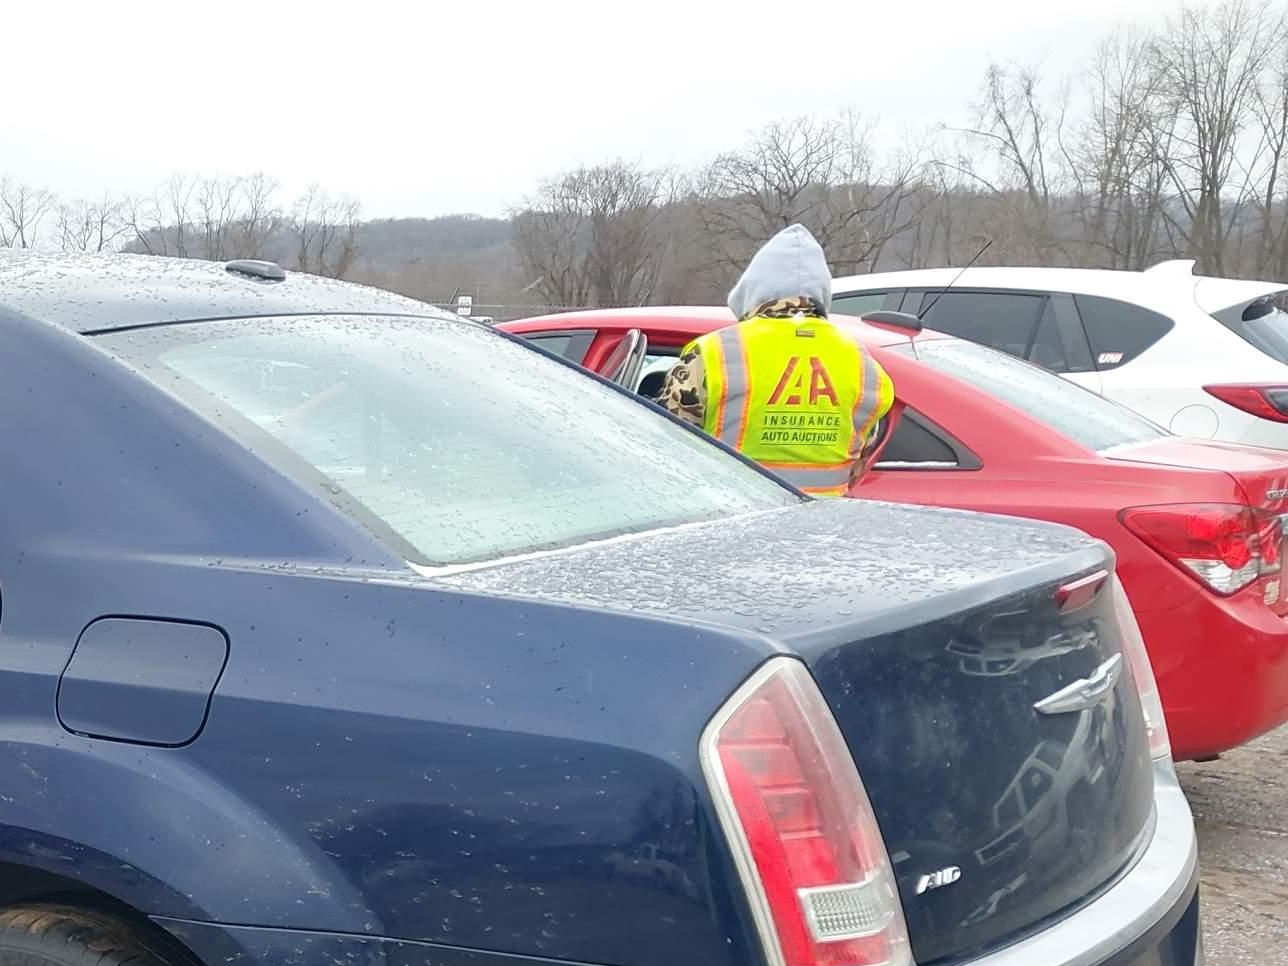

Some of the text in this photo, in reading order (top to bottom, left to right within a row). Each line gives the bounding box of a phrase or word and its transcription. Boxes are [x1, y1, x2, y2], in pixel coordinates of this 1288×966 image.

[763, 415, 840, 426] INSURANCE
[761, 431, 837, 442] AUTO AUCTIONS
